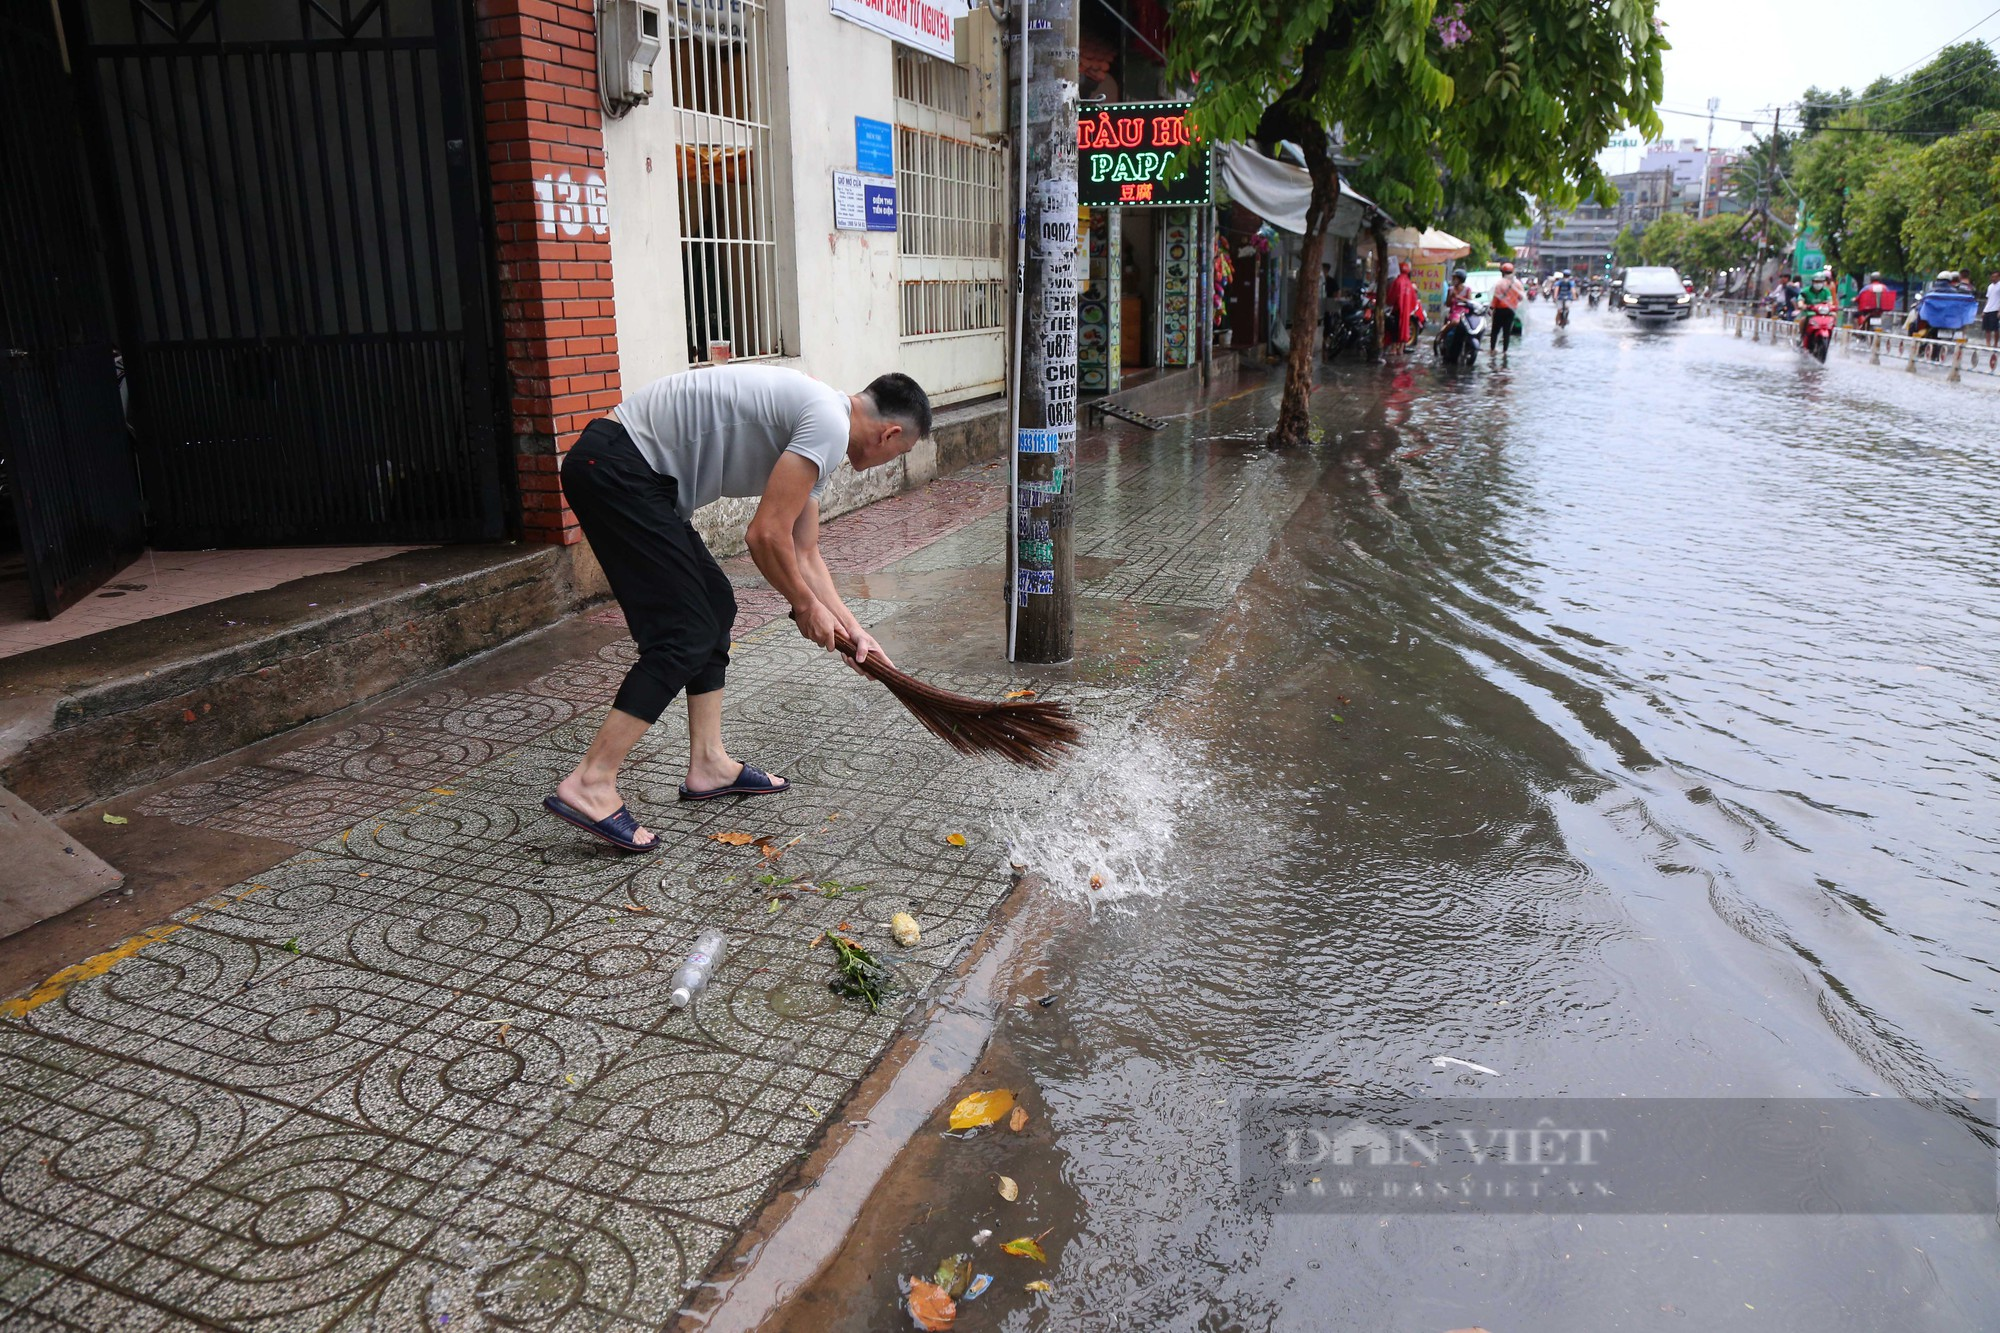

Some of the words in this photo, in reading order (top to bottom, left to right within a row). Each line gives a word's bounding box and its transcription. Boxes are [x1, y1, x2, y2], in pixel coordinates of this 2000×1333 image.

[921, 6, 949, 46] NGUYỆN
[1119, 183, 1153, 201] 豆腐
[535, 172, 608, 235] 136
[884, 197, 893, 206] THU
[1046, 364, 1076, 382] CHO
